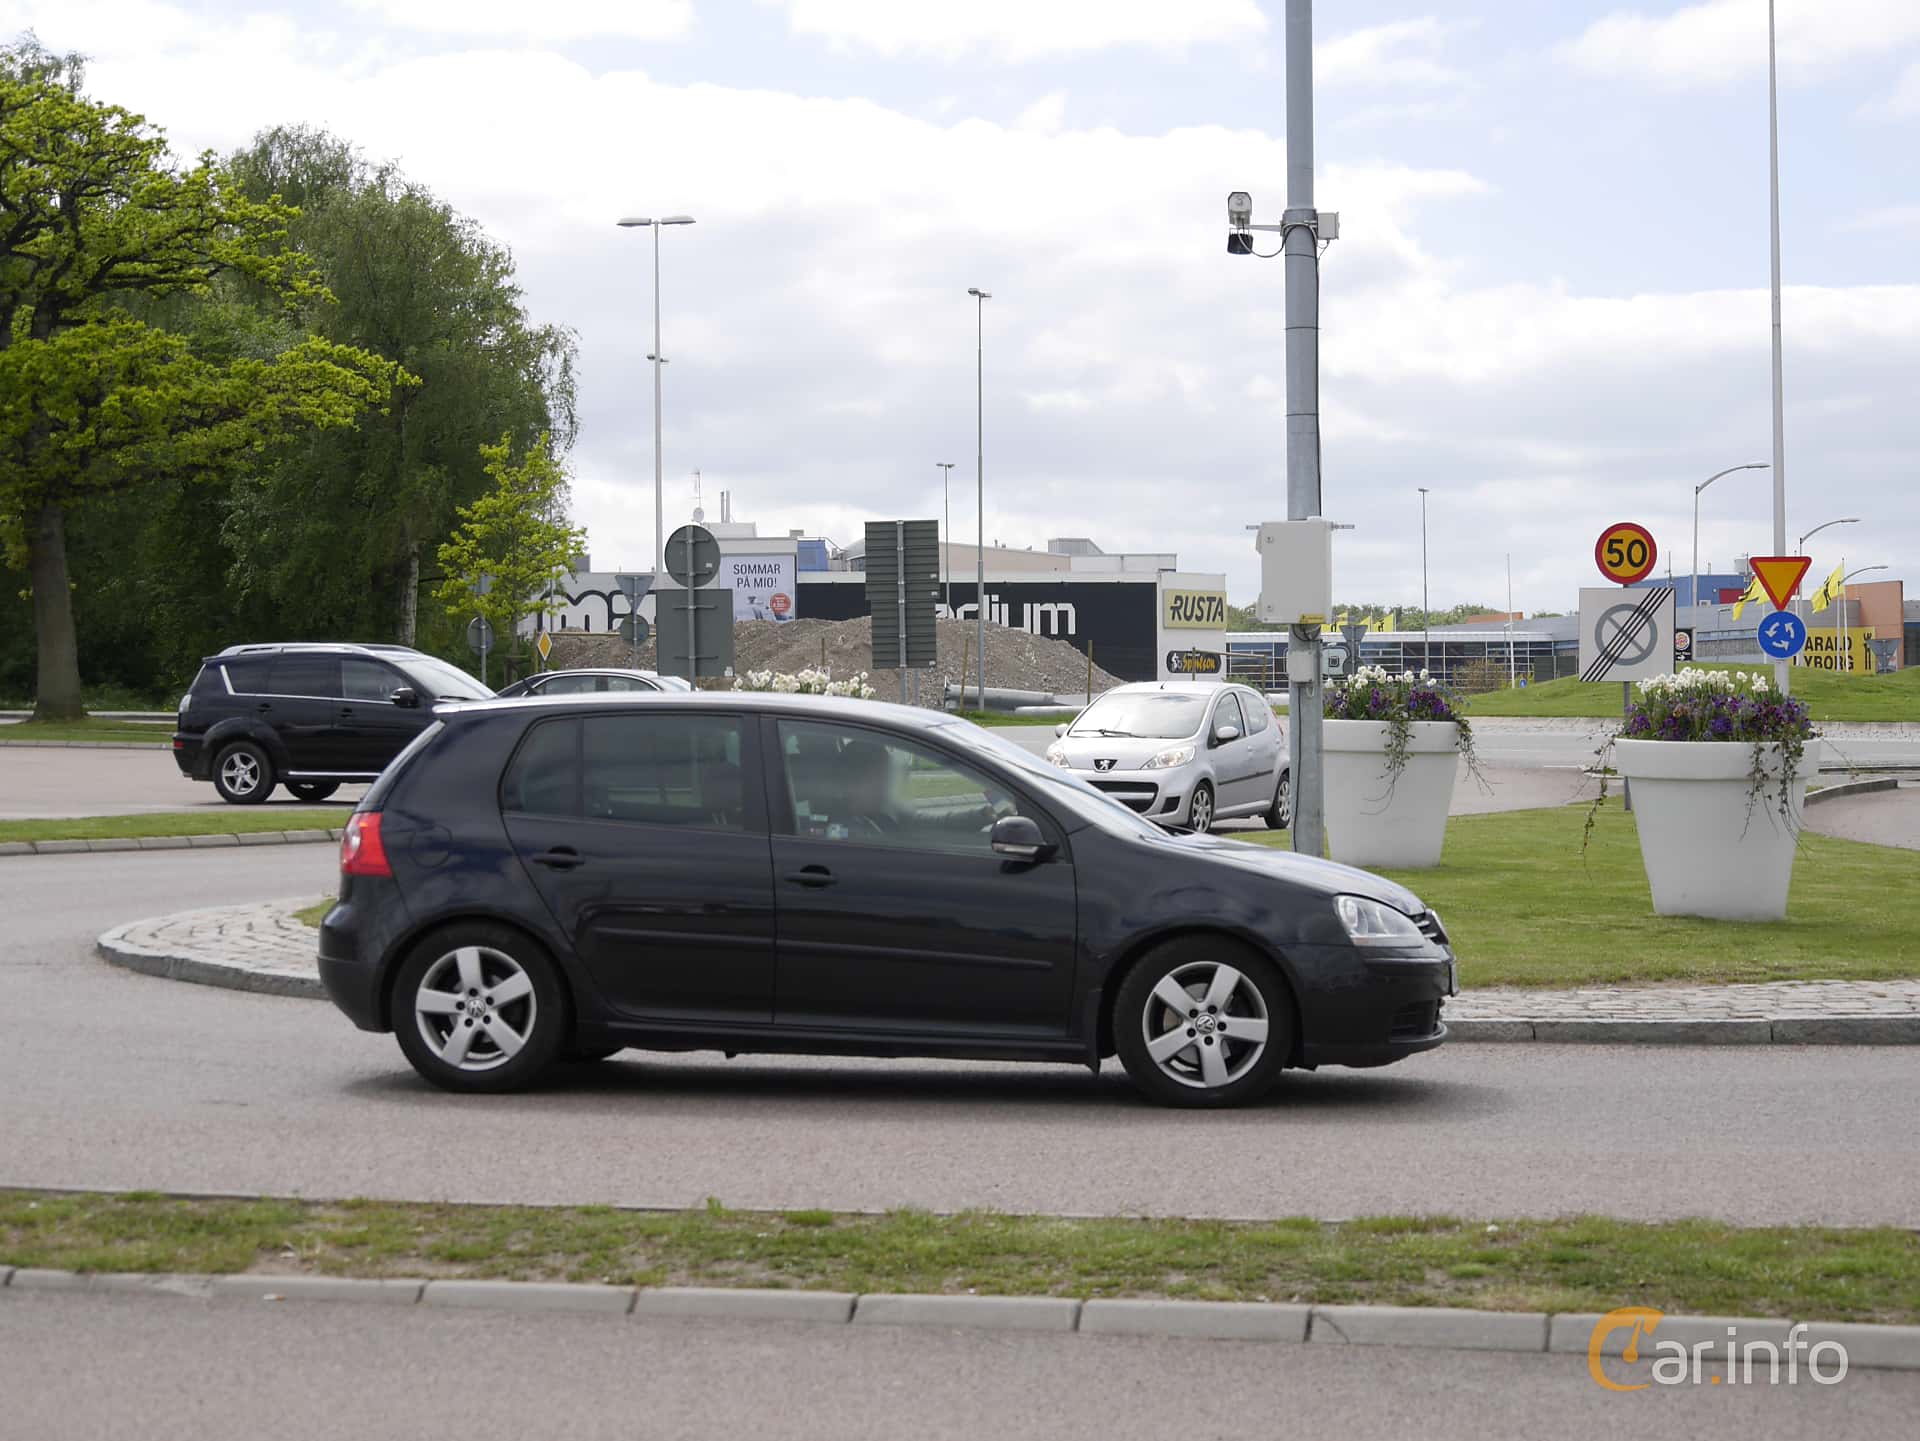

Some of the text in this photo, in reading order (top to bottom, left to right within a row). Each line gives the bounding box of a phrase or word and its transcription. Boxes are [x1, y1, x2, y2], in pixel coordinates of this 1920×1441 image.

[1607, 538, 1647, 568] 50
[733, 563, 781, 575] SOMMAR
[737, 575, 777, 588] PÅ MIO!
[1170, 595, 1224, 622] RUSTA
[1805, 636, 1853, 652] ARALD
